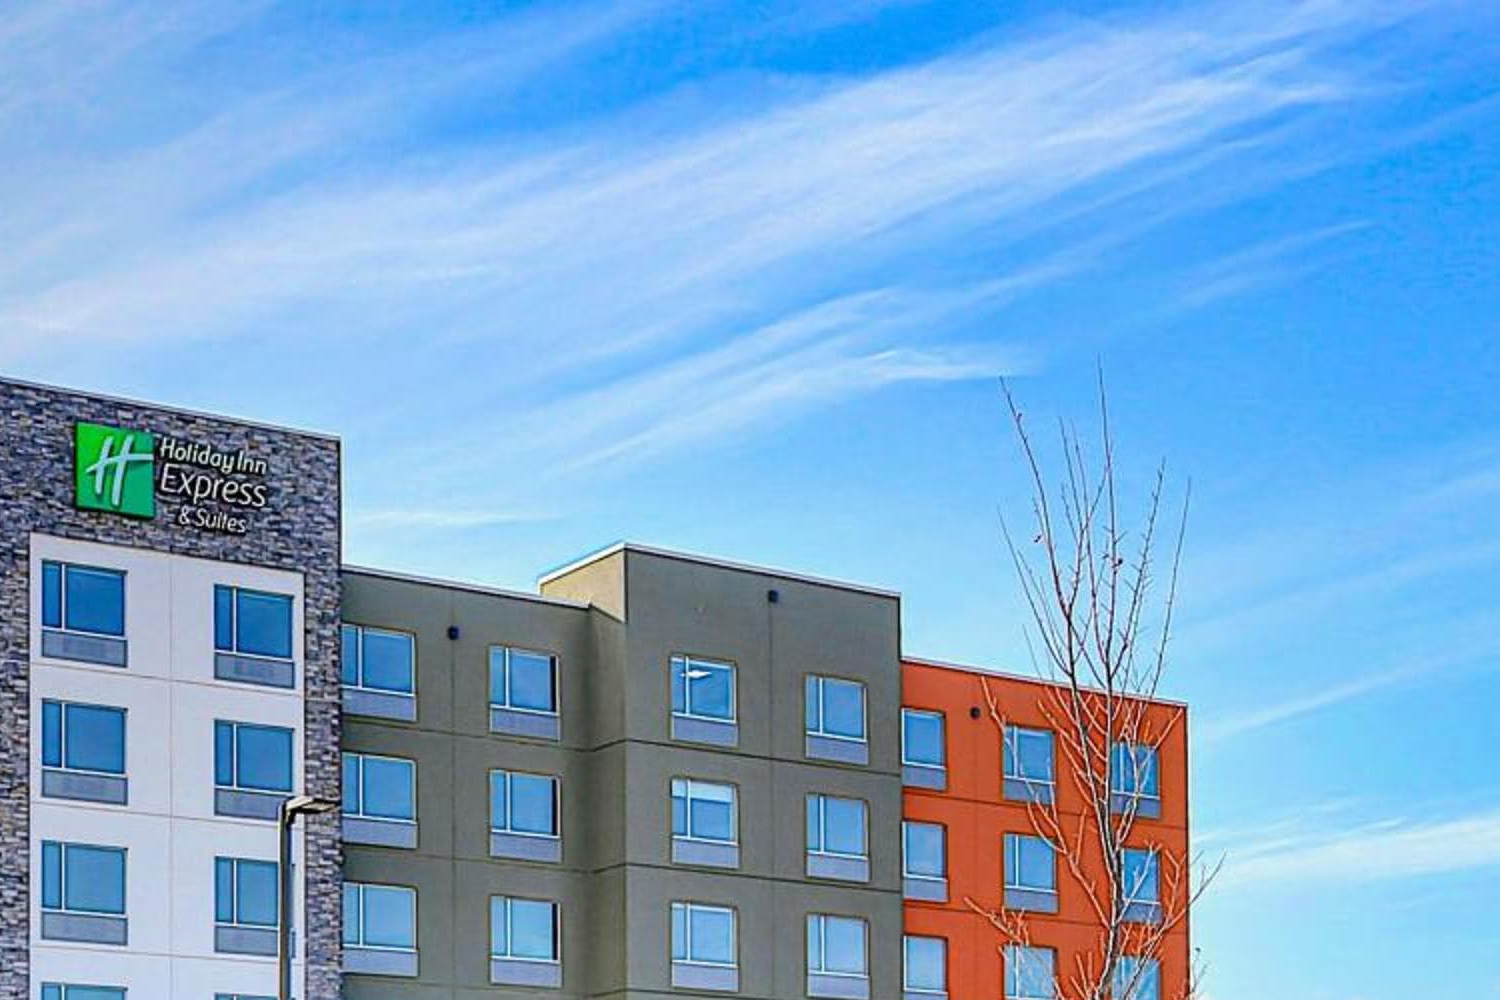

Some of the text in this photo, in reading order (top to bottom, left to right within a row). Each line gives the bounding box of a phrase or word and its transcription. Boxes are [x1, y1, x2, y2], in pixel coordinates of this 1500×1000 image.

[160, 436, 267, 475] Holiday Inn
[161, 463, 267, 507] Express
[179, 505, 247, 533] & Suites
